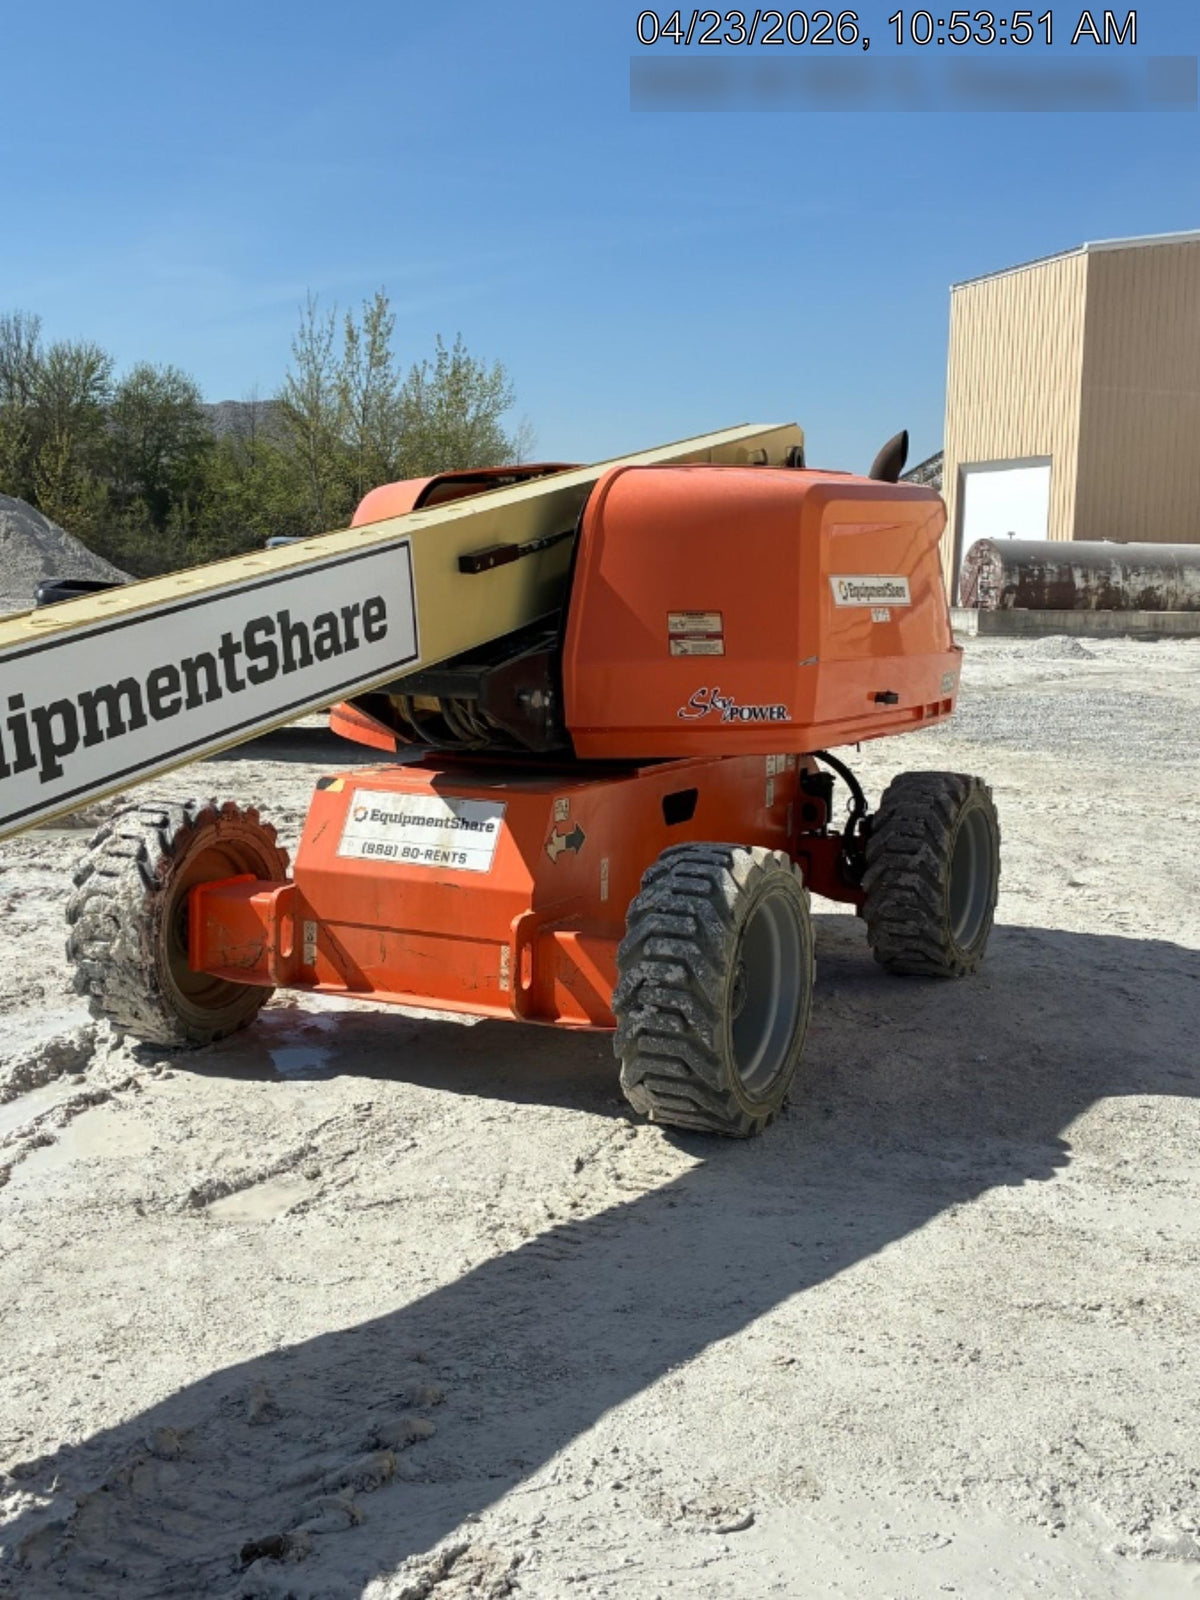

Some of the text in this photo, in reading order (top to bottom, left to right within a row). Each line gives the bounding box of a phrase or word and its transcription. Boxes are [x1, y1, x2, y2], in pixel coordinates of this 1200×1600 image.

[0, 595, 388, 784] ipmentShare
[729, 704, 787, 721] POWER
[370, 808, 495, 832] EquipmentShare
[361, 842, 468, 864] (888) 80-RENTS
